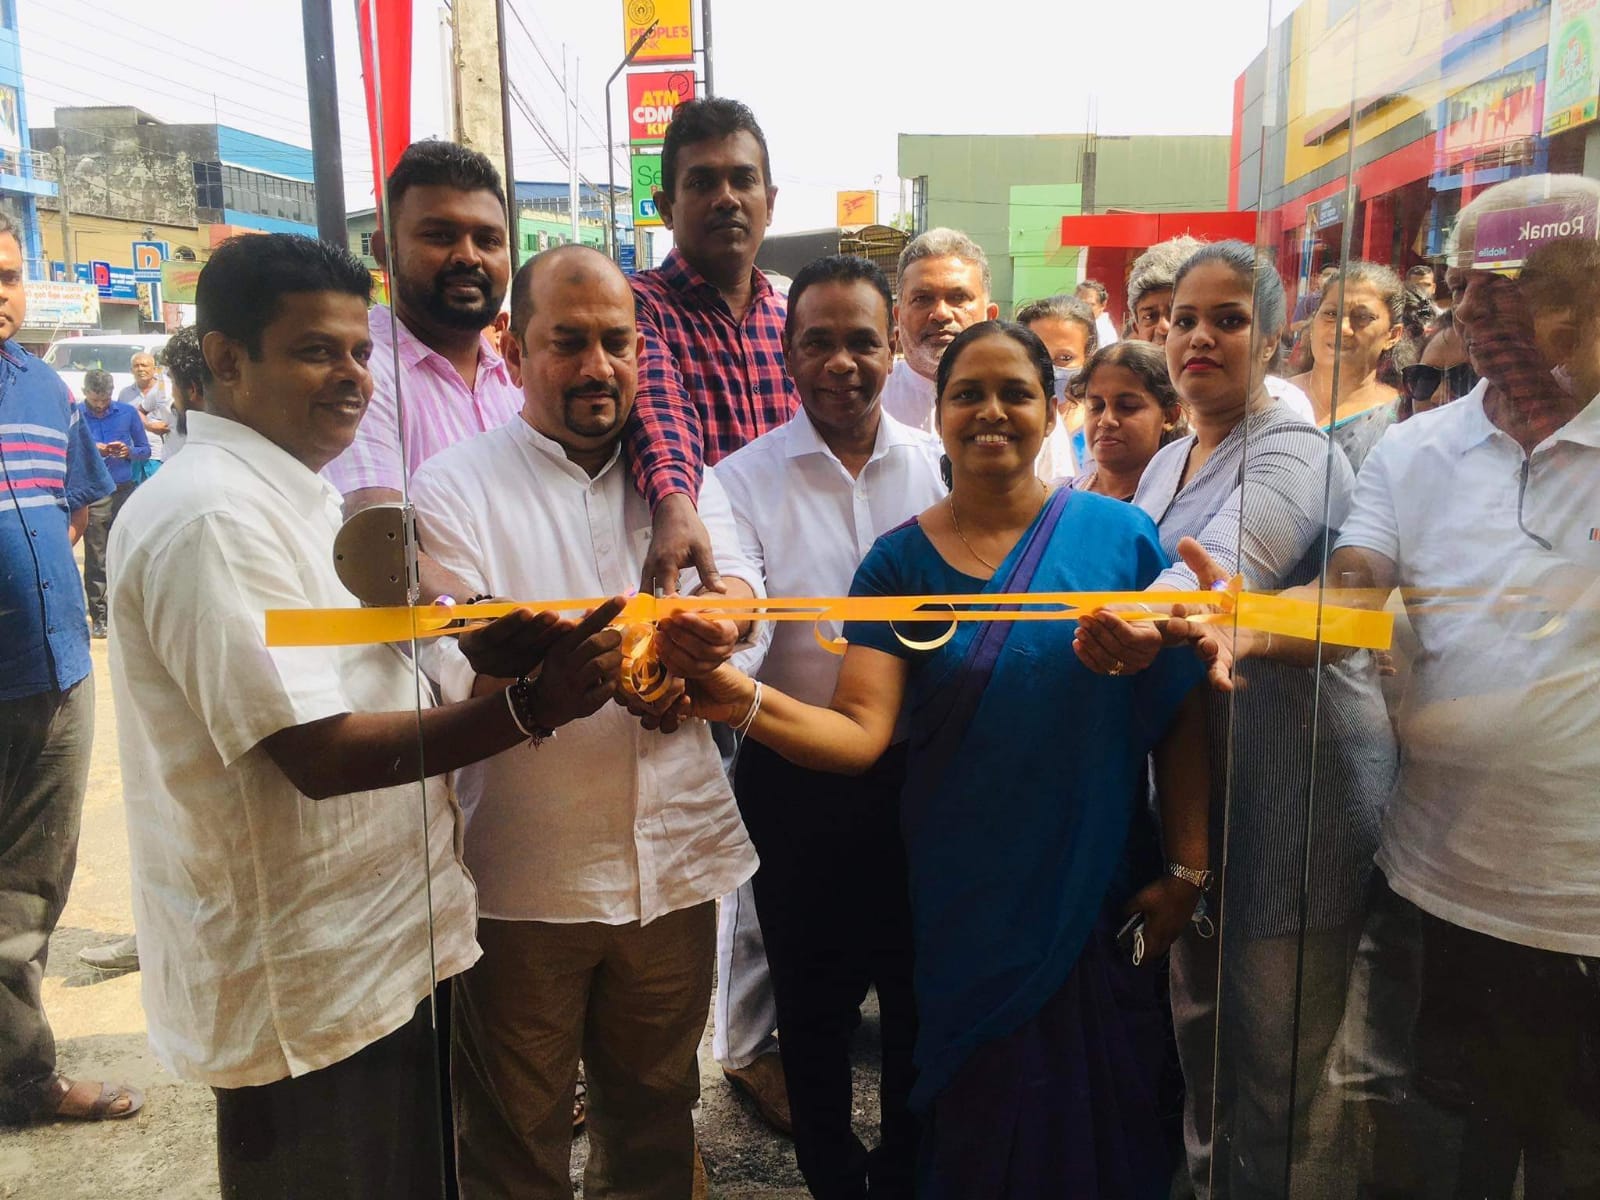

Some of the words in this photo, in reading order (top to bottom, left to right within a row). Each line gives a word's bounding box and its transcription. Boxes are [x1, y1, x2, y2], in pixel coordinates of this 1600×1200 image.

[630, 25, 689, 40] PEOPLE'S
[641, 90, 680, 107] ATM
[638, 165, 663, 186] Se
